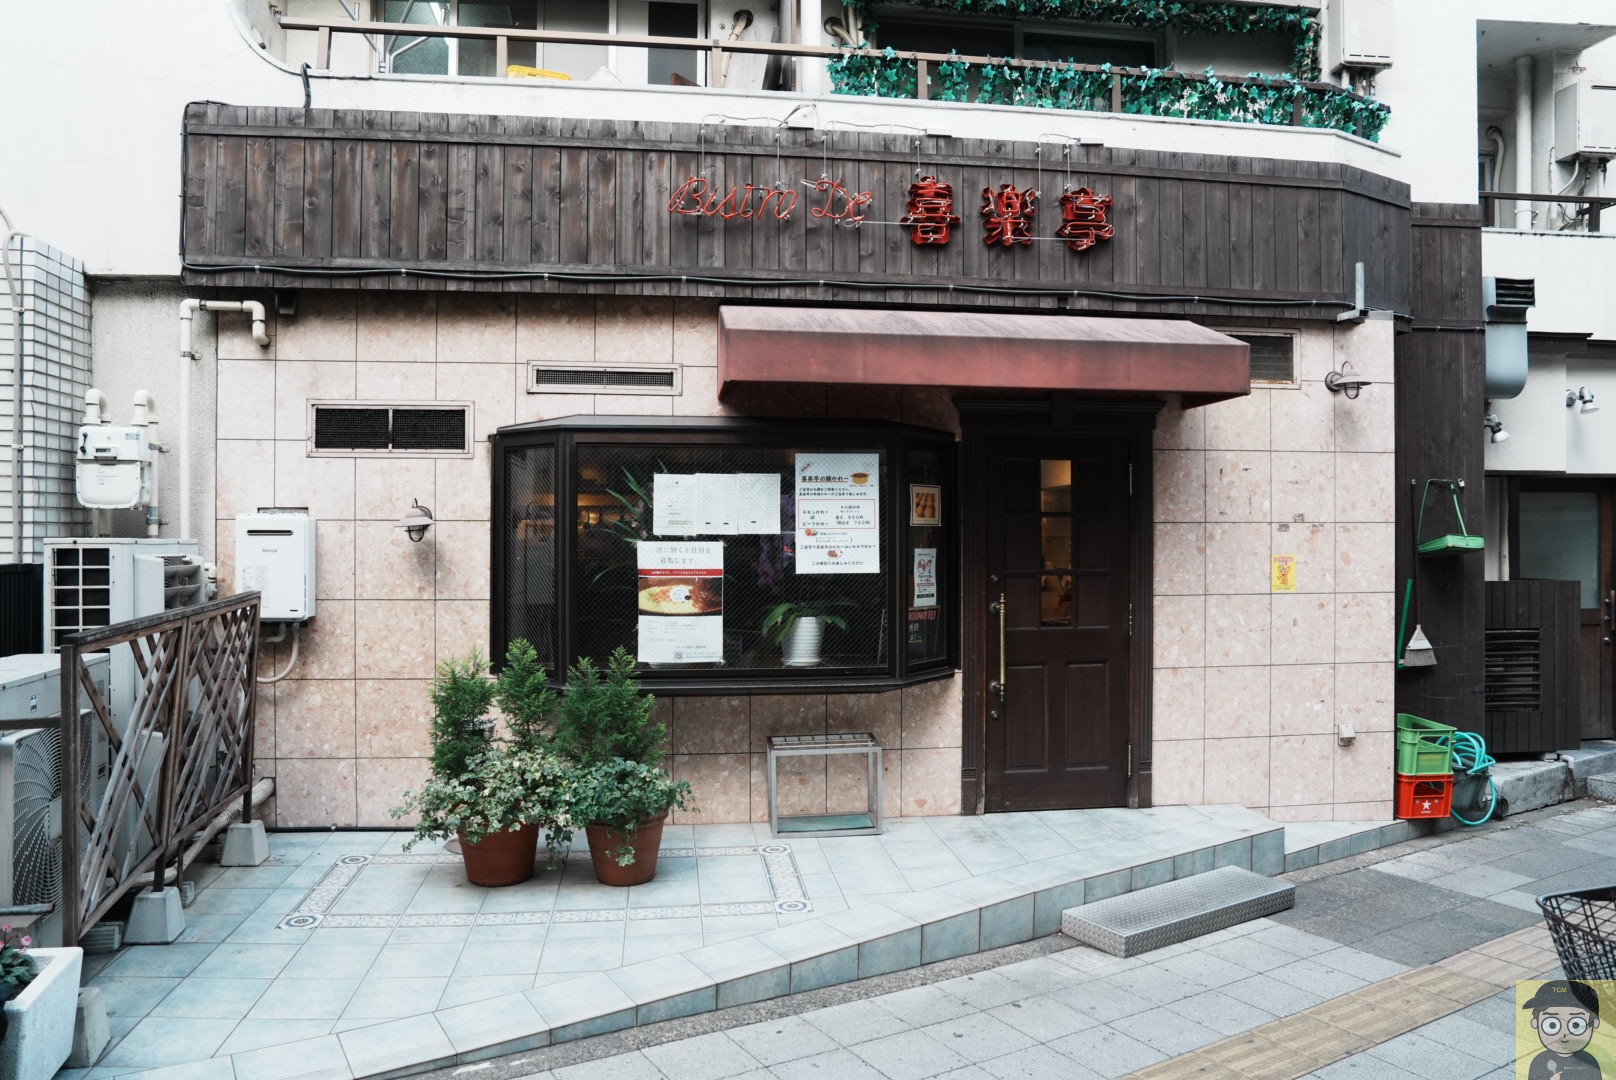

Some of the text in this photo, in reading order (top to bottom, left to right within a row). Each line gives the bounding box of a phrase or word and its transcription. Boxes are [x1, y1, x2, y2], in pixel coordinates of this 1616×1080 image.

[667, 176, 797, 219] Bistro
[811, 179, 873, 221] De
[650, 546, 712, 554] 緒に働く正社員を
